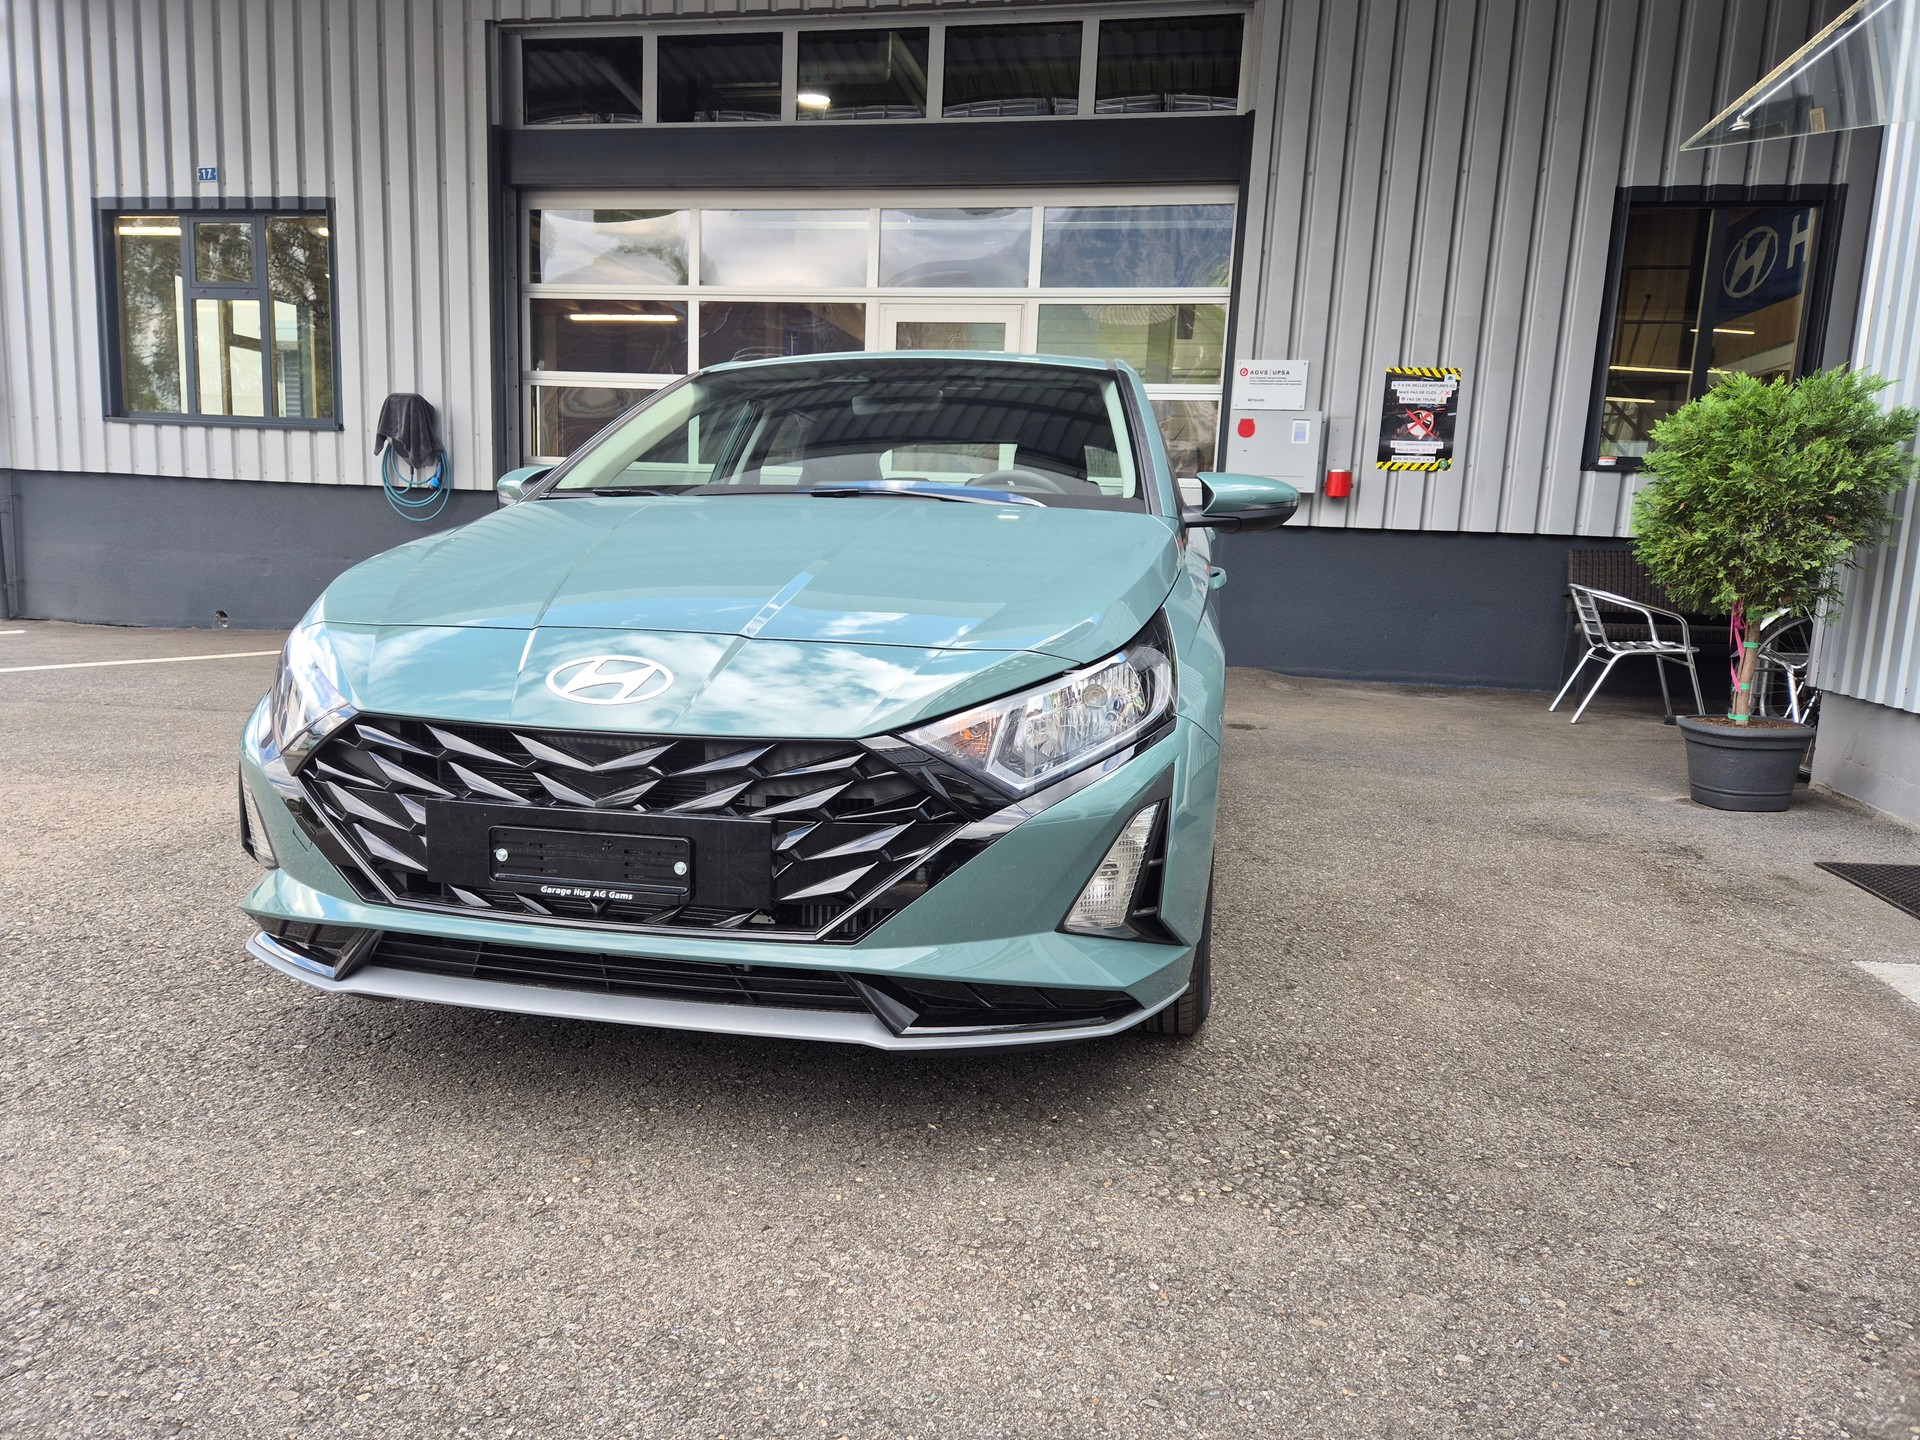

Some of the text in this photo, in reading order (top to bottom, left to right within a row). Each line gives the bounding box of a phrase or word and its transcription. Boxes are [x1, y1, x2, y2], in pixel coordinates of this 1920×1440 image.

[201, 168, 212, 179] 17
[540, 885, 633, 900] Garage Hug AG Gams
